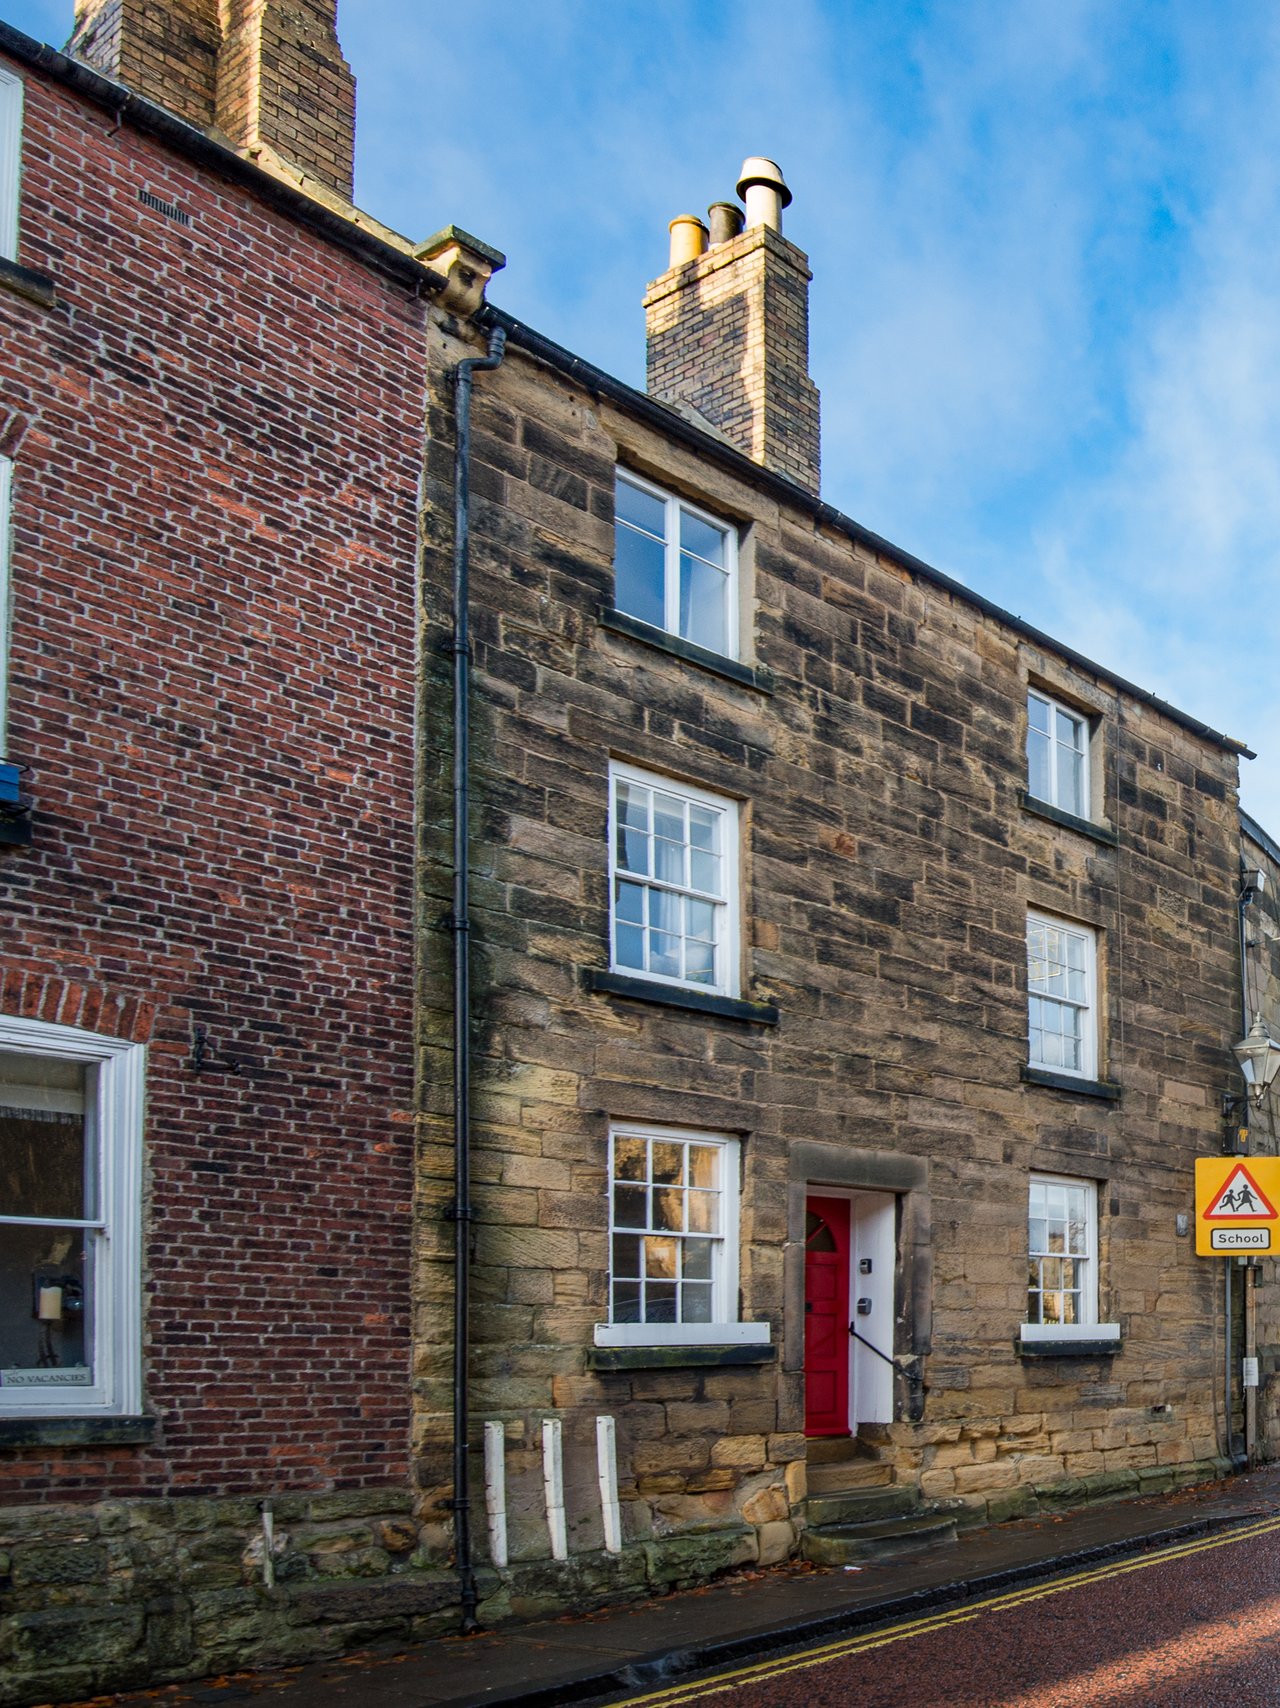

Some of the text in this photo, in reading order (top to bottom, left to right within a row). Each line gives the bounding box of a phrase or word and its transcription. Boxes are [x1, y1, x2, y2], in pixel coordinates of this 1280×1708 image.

[1218, 1234, 1264, 1243] School
[7, 1374, 86, 1384] NO VACANCIES
